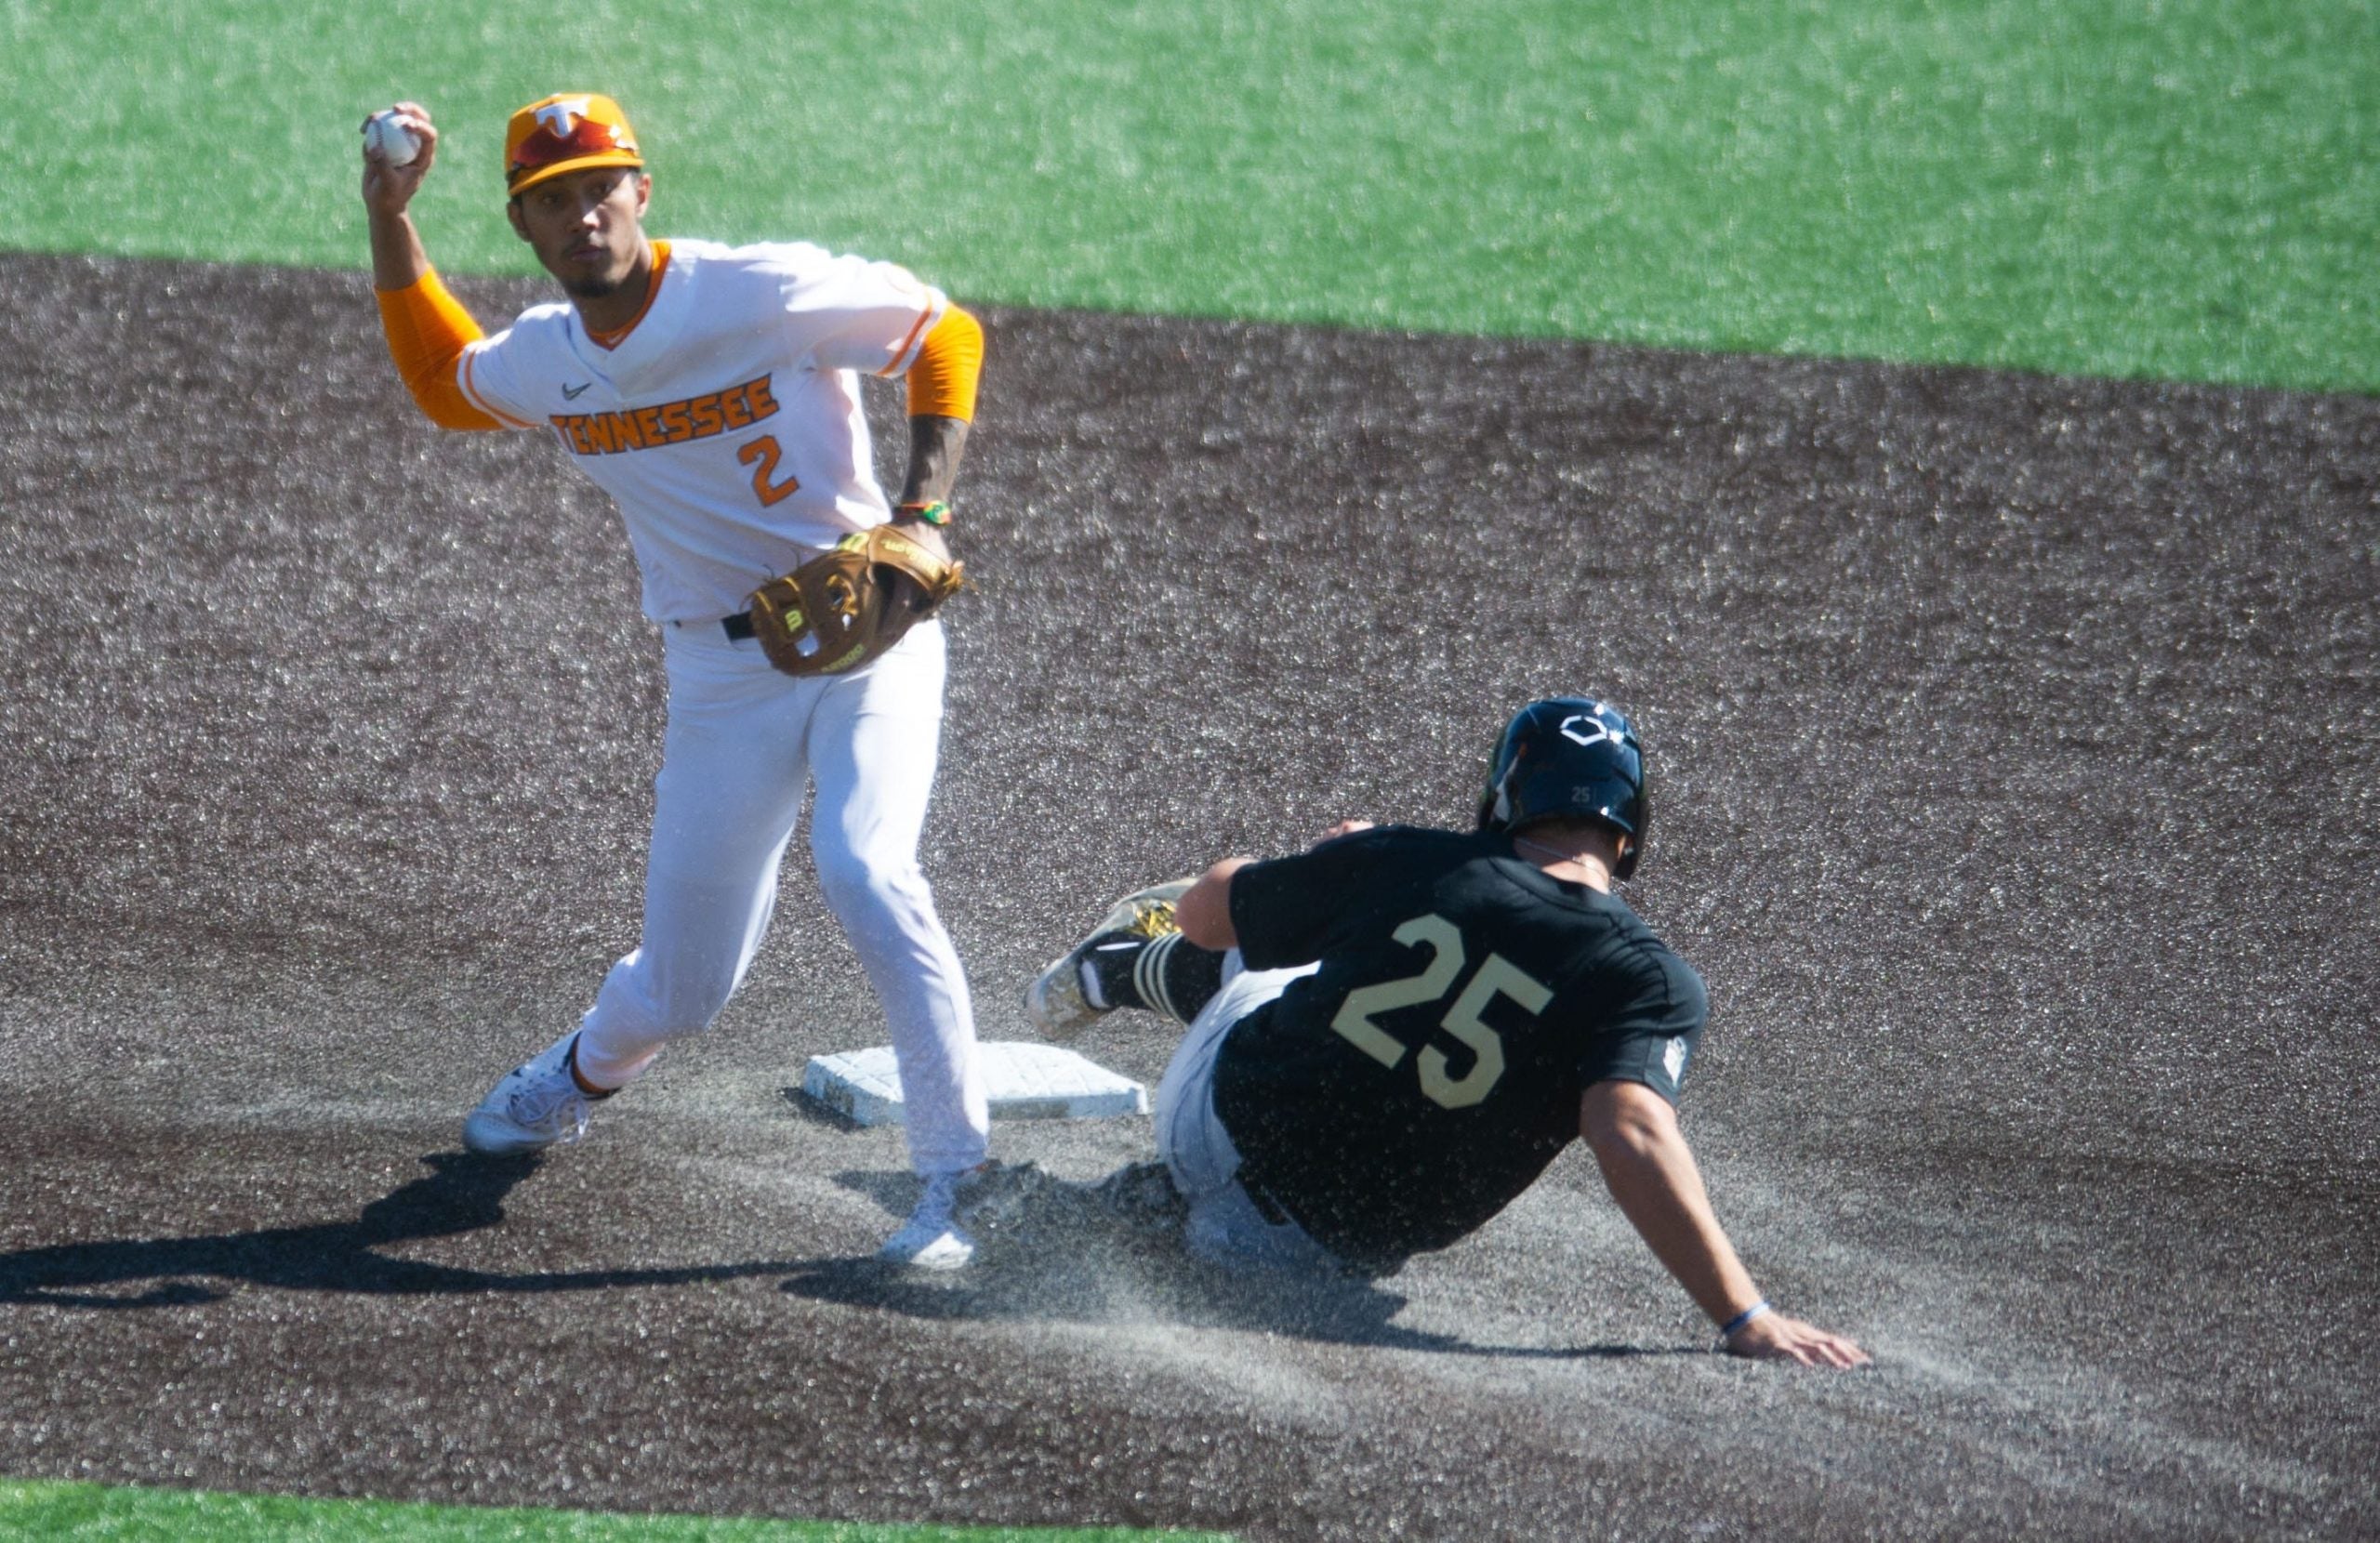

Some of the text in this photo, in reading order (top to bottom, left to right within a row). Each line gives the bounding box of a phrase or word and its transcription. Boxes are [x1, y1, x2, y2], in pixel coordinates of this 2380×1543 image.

[536, 99, 589, 138] T
[549, 372, 780, 455] TENNESSEE
[736, 434, 800, 508] 2
[1571, 786, 1591, 803] 25
[1330, 913, 1554, 1110] 25
